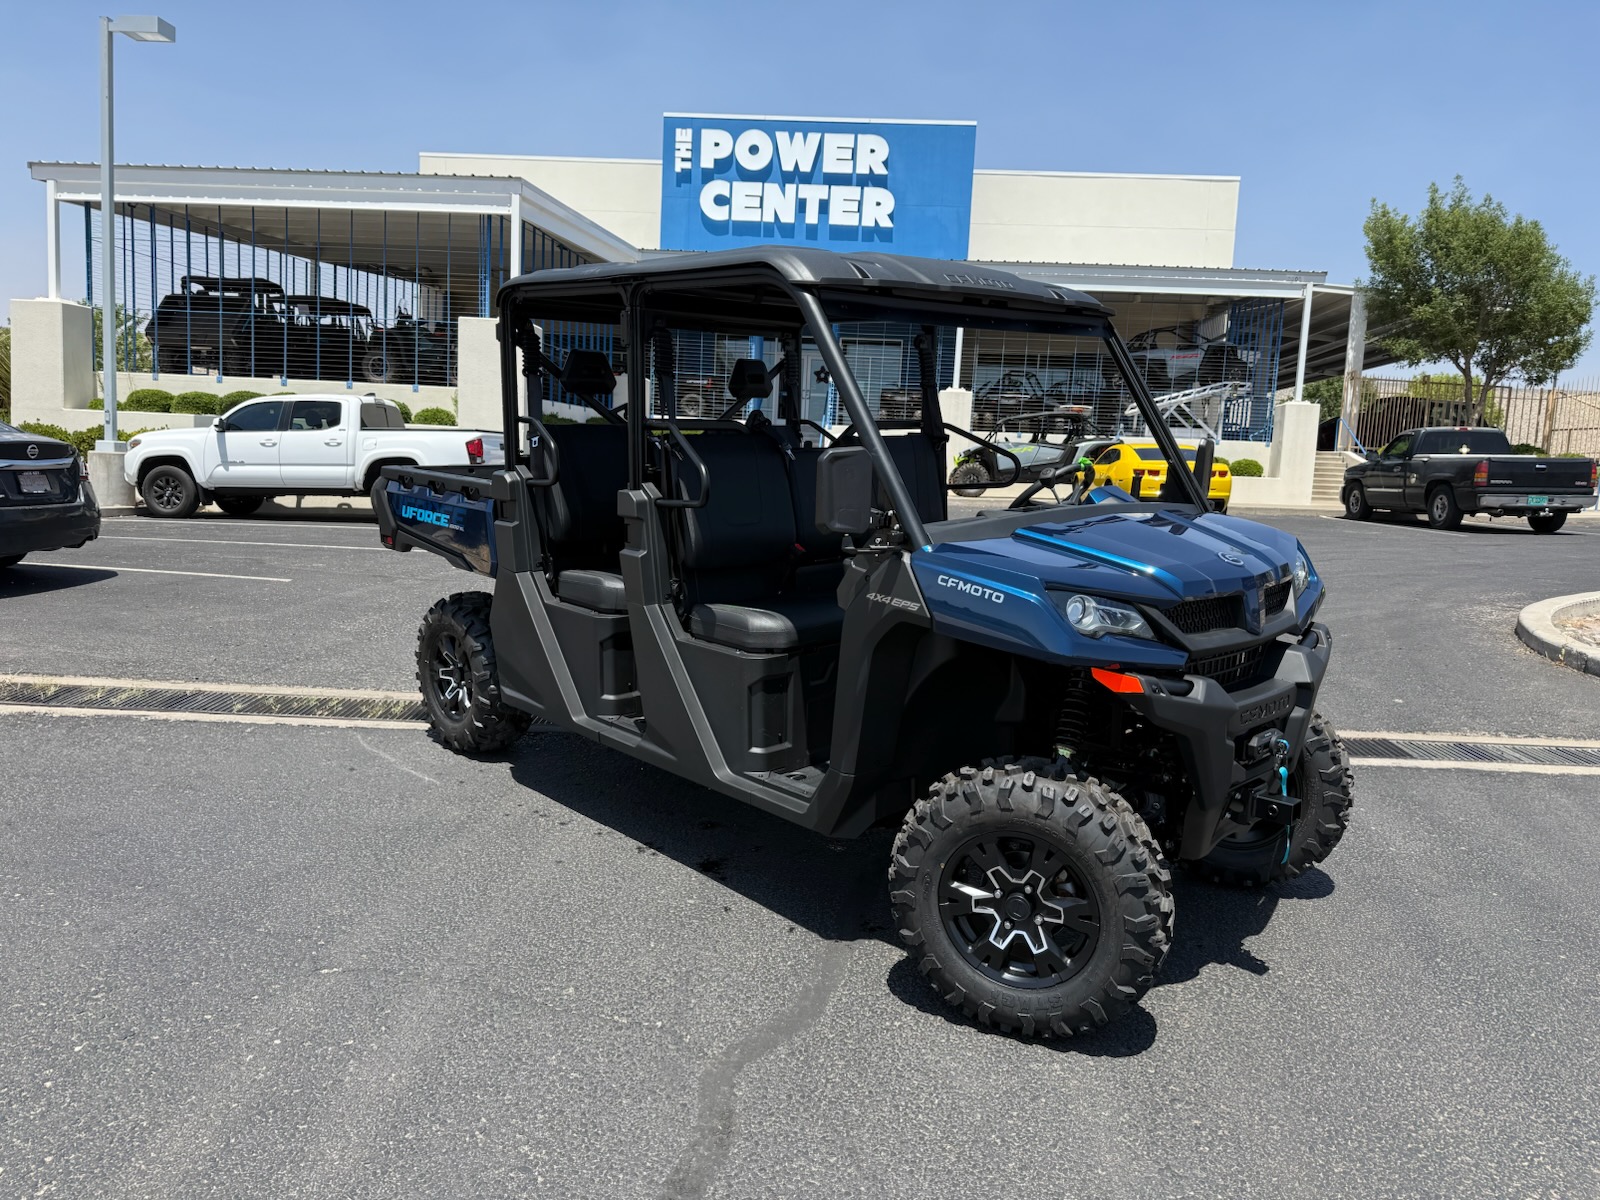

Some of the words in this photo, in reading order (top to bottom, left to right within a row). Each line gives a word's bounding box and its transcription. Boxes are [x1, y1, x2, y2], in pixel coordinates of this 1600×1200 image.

[675, 128, 693, 173] THE
[700, 128, 890, 175] POWER
[699, 179, 896, 228] CENTER
[401, 505, 450, 528] UFORCE
[866, 592, 891, 604] 4X4
[891, 598, 921, 611] EPS
[937, 574, 1005, 604] CFMOTO
